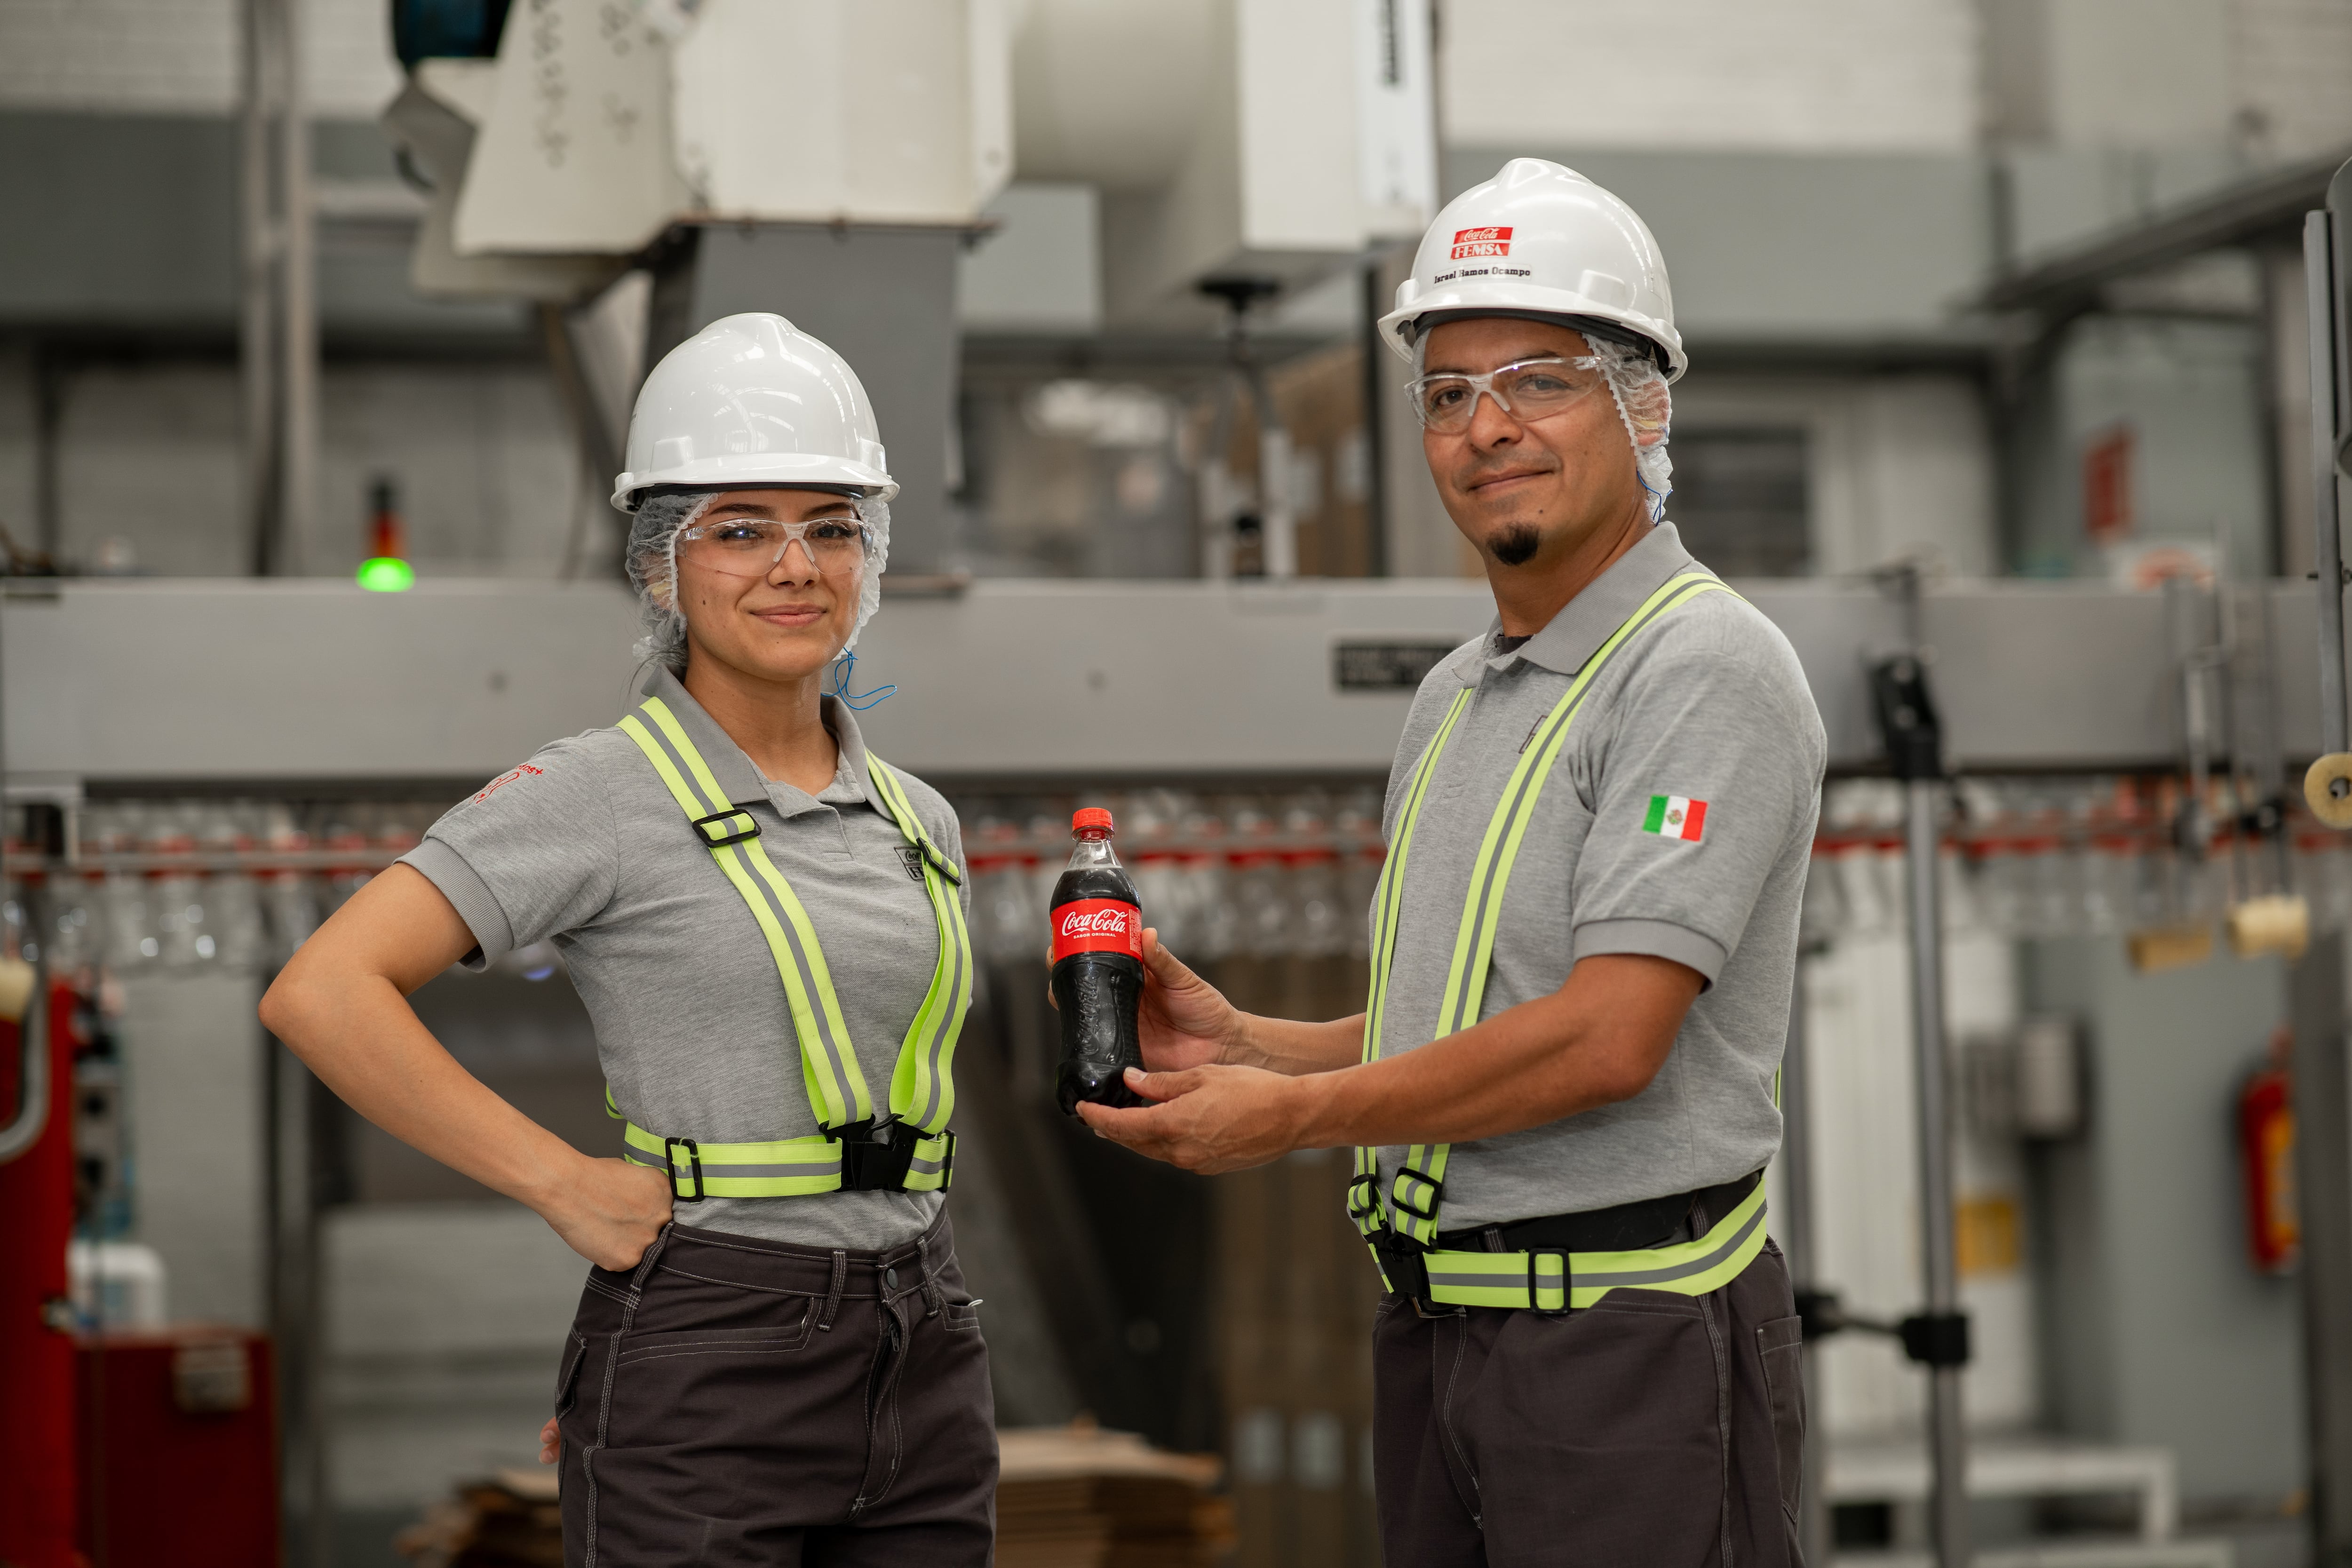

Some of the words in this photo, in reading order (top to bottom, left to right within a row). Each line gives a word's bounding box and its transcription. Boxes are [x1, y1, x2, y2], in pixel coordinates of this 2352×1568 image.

[1464, 228, 1501, 241] Coca-Cola
[1454, 243, 1503, 259] FEMSA
[1434, 271, 1456, 284] Israel
[1458, 269, 1488, 278] Ramos
[1492, 267, 1531, 277] Ocampo
[1062, 908, 1128, 936] Coca-Cola
